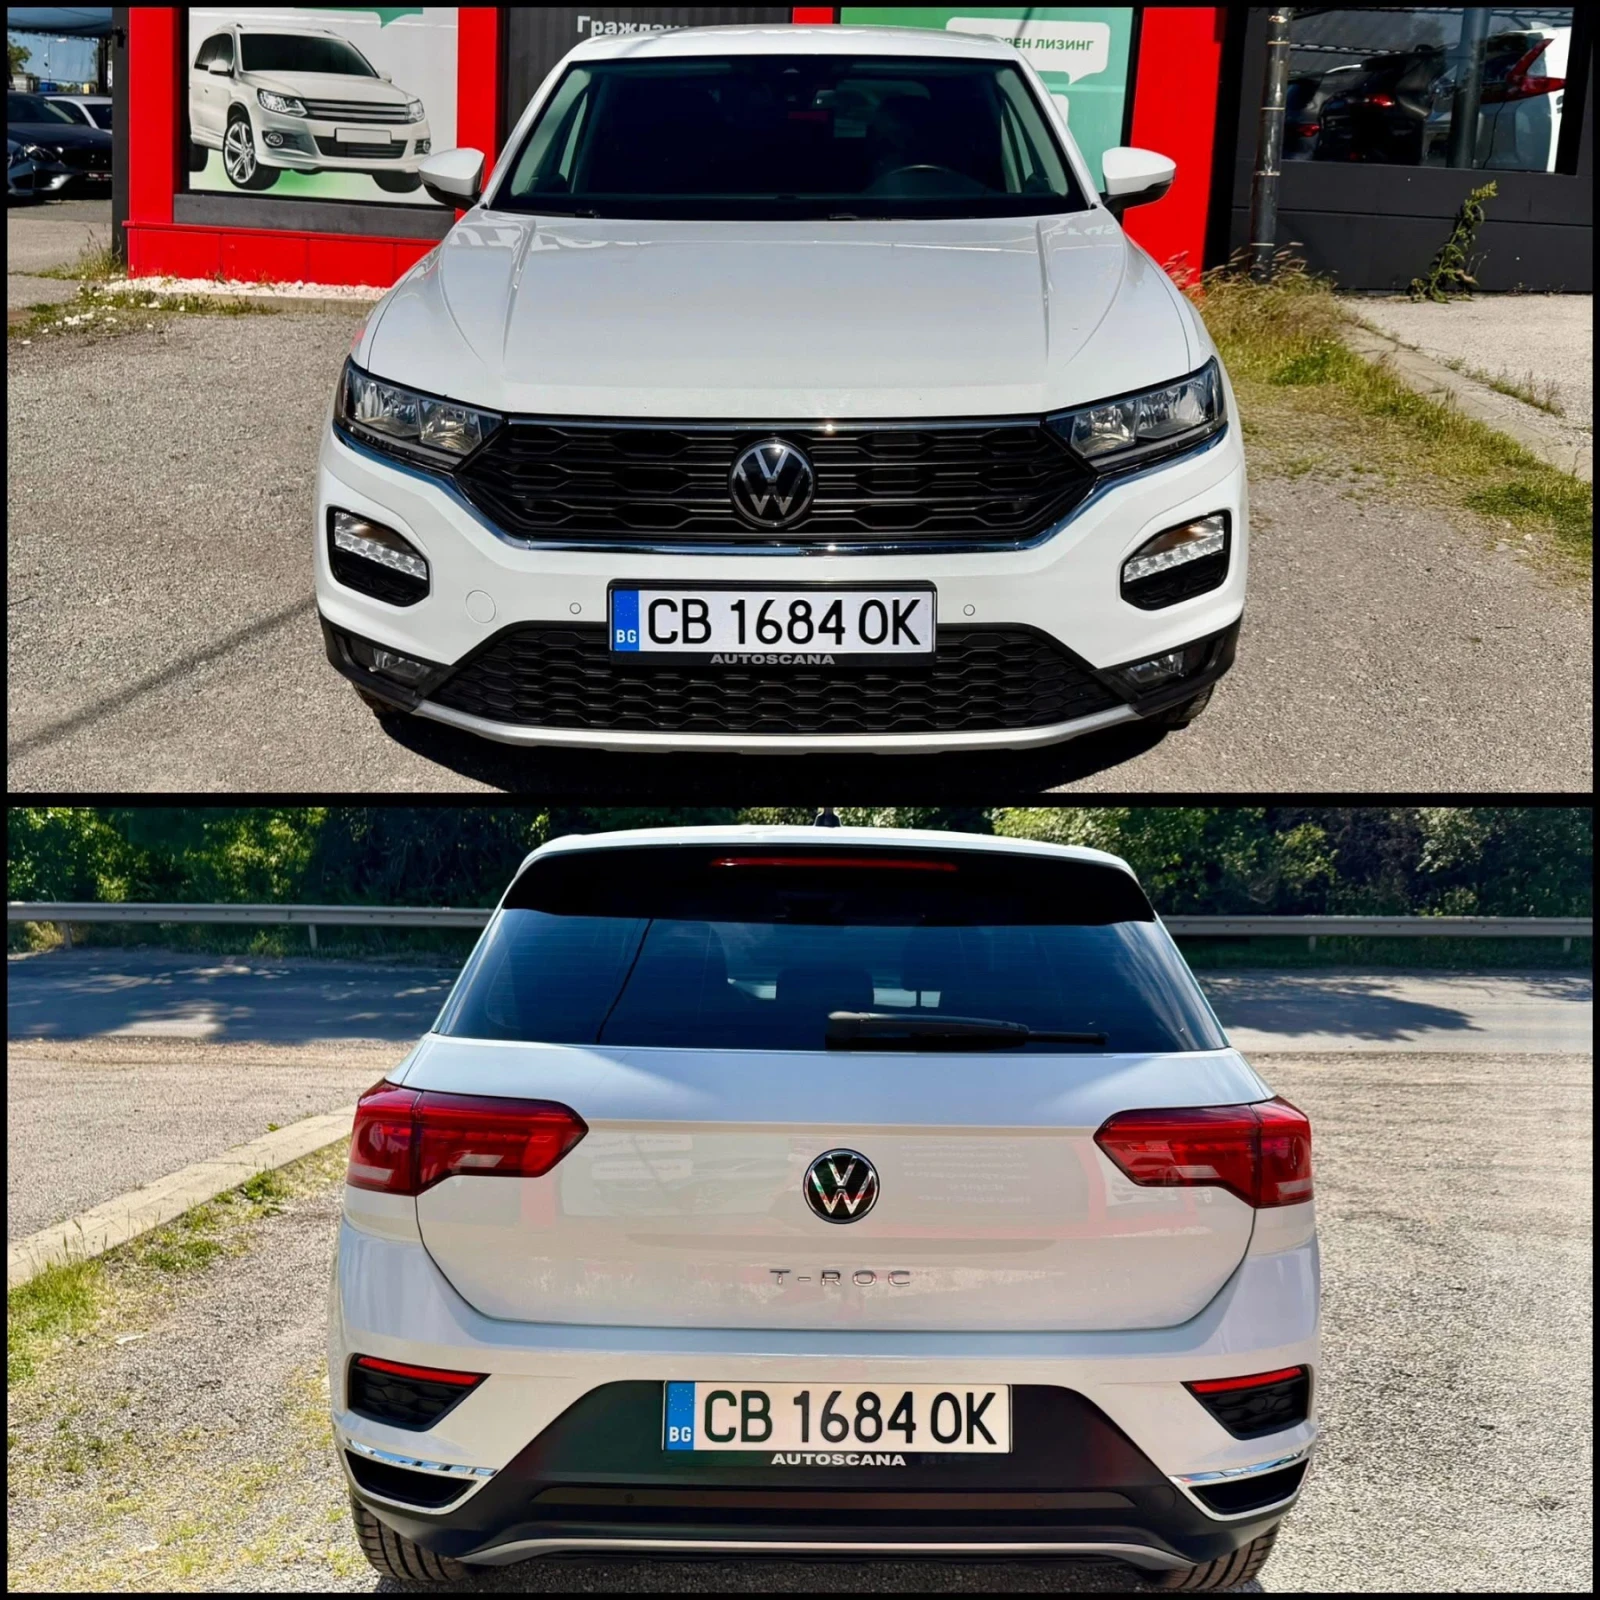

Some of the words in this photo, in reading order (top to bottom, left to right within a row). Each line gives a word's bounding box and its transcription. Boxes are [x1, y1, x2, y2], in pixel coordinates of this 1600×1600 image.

[577, 15, 690, 37] Гражд
[1035, 38, 1094, 51] ЛИЗИНГ
[616, 629, 637, 644] BG
[648, 598, 712, 645] CB
[730, 598, 846, 646] 1684
[858, 598, 921, 646] OK
[710, 653, 836, 666] AUTOSCANA
[769, 1268, 911, 1288] T-ROC
[668, 1426, 692, 1443] BG
[704, 1389, 773, 1444] CB
[793, 1390, 917, 1445] 1684
[930, 1391, 998, 1446] OK
[771, 1452, 907, 1467] AUTOSCANA
